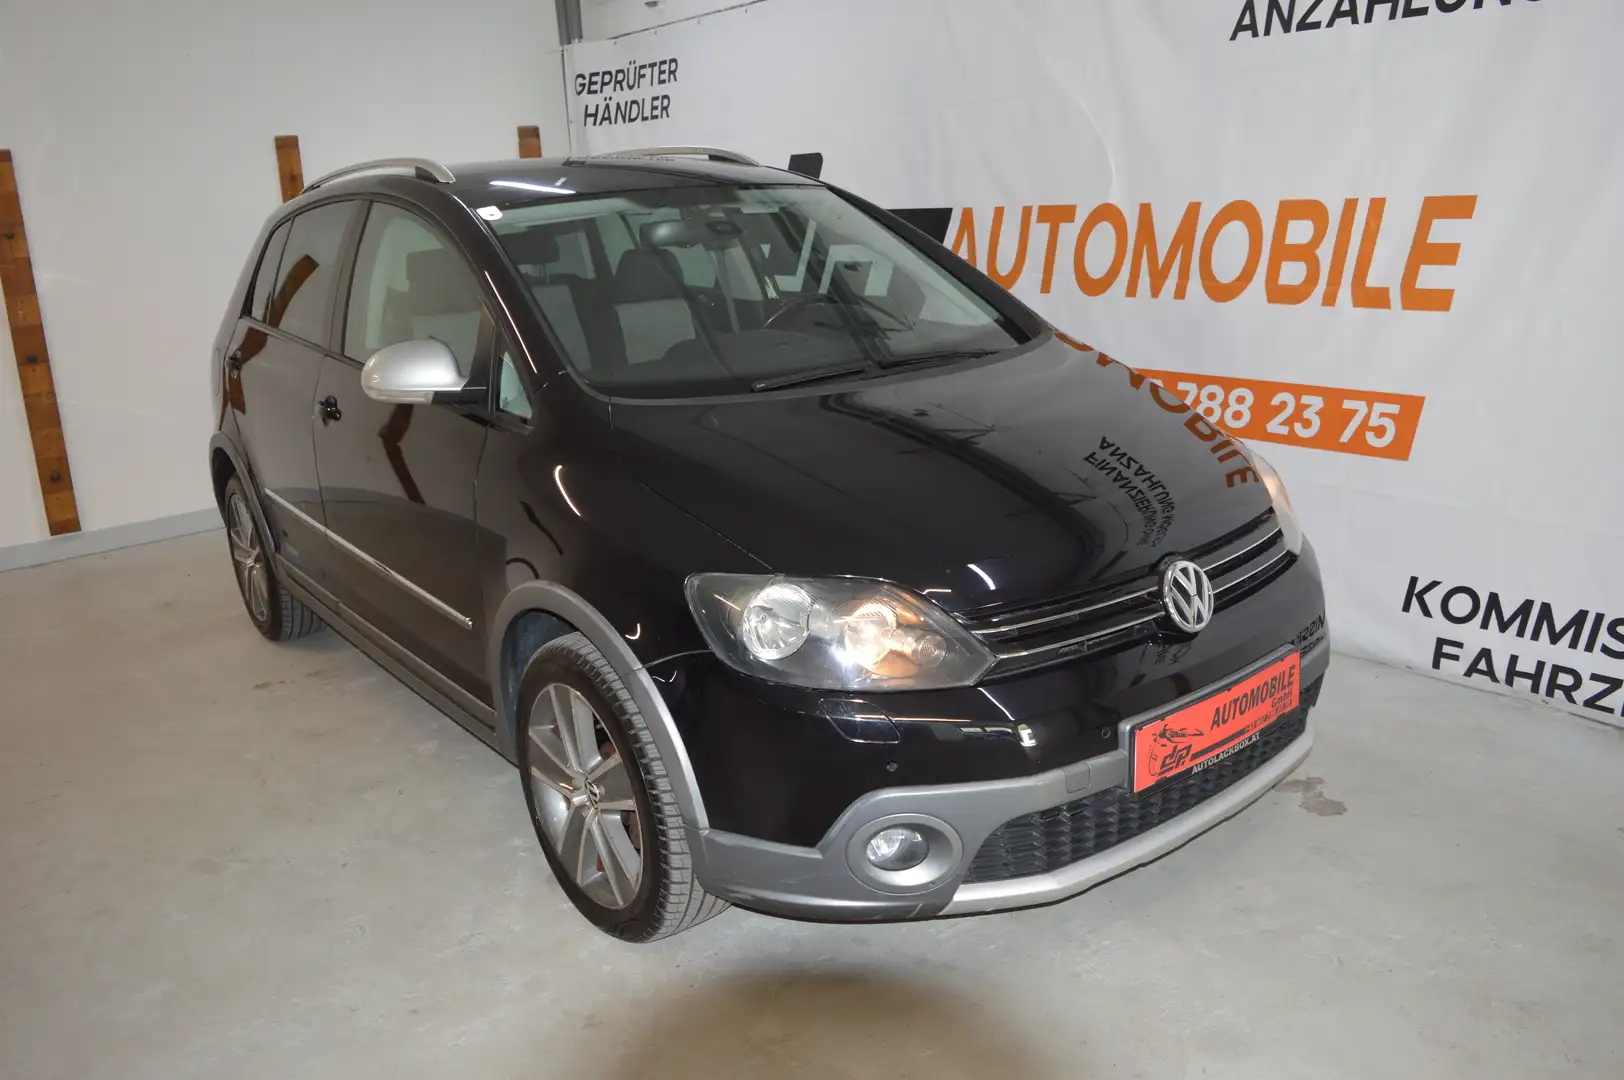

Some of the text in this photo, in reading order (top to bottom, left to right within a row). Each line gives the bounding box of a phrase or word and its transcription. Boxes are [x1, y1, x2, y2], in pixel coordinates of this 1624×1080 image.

[575, 58, 678, 96] GEPRÜFTER
[584, 94, 670, 127] HÄNDLER
[951, 194, 1478, 312] AUTOMOBILE
[1266, 392, 1325, 437] 23
[1339, 400, 1400, 448] 75
[1210, 664, 1295, 731] AUTOMOBILE
[1431, 636, 1624, 718] FAHRZ
[1192, 732, 1260, 775] AUTOLACKBOX.AT
